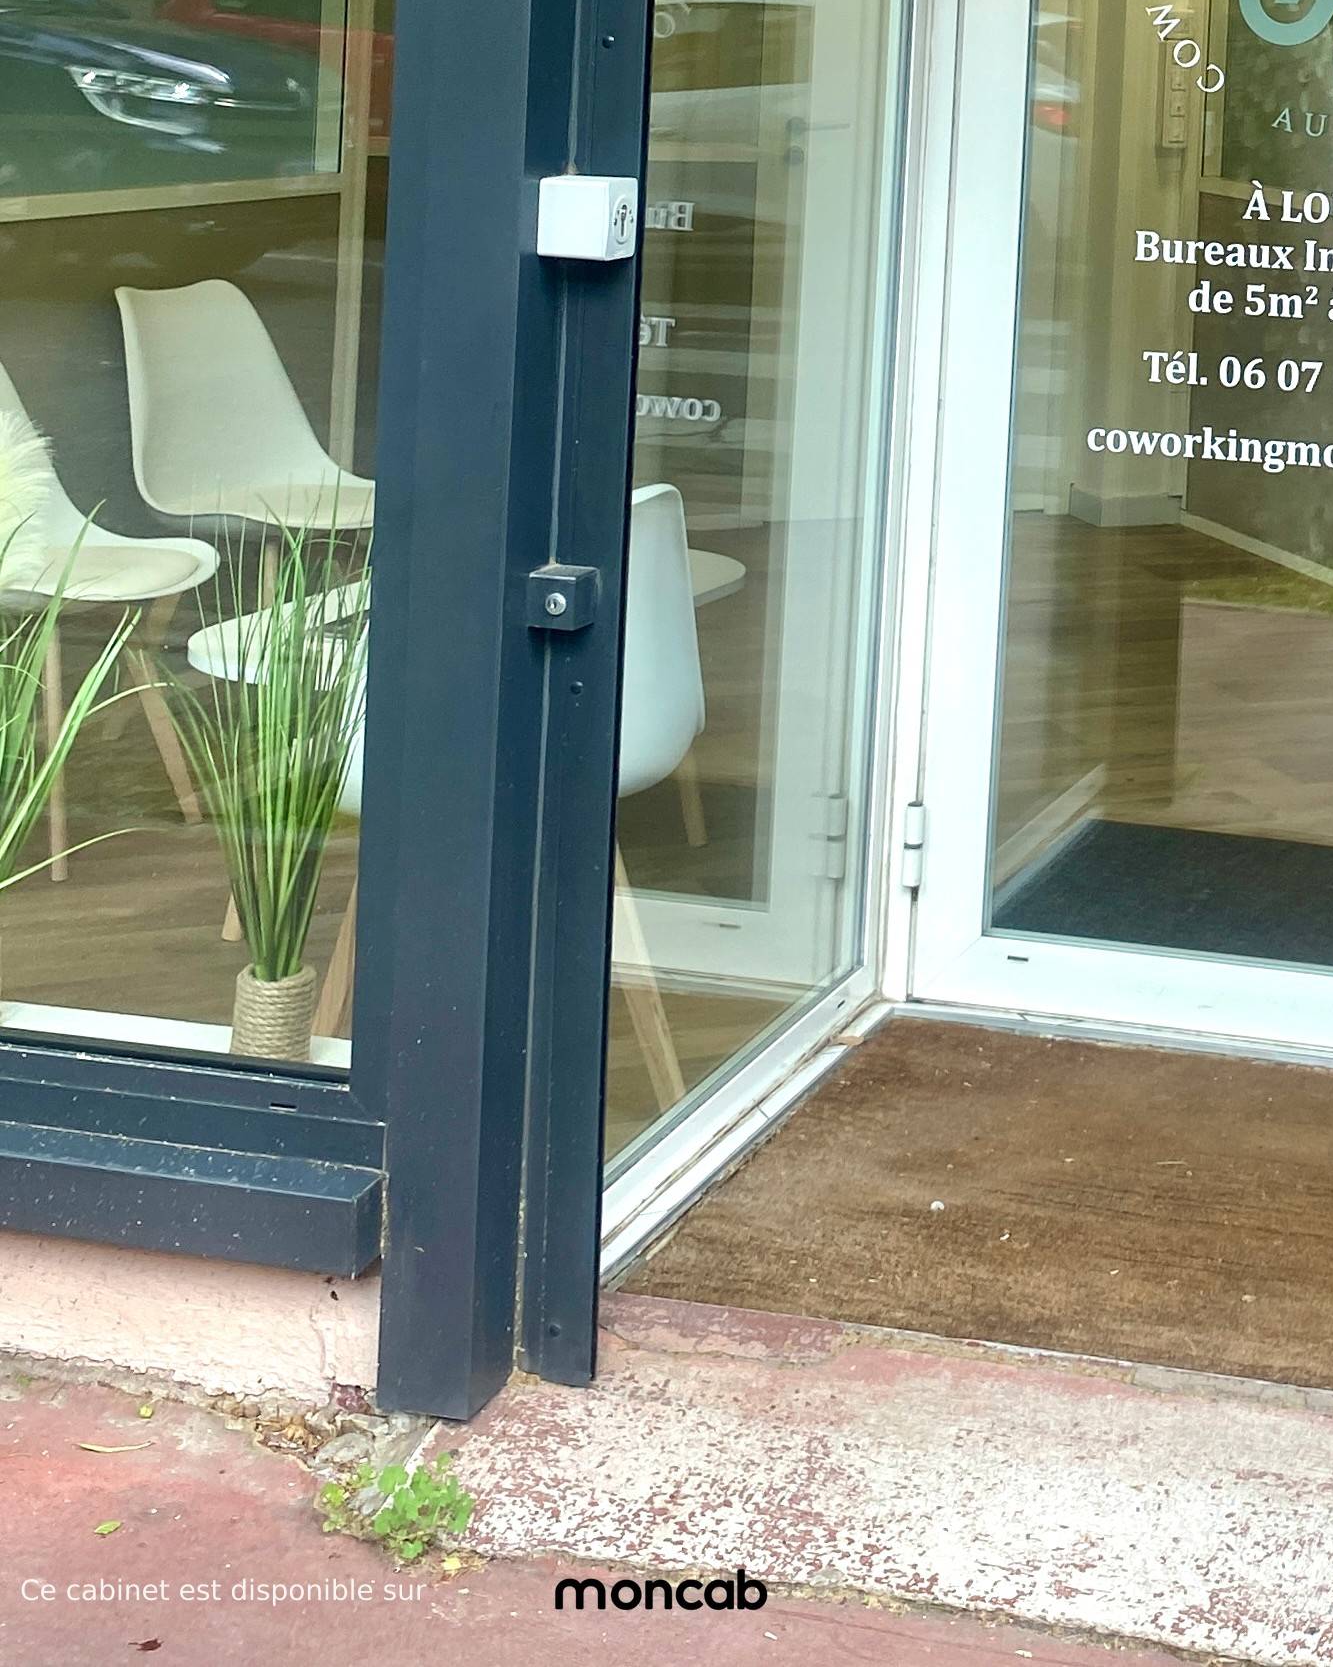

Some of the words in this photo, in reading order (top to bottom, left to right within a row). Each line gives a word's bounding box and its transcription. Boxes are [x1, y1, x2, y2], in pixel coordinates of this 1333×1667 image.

[1272, 107, 1329, 137] AU
[1242, 179, 1271, 222] À
[1134, 230, 1294, 270] Bureaux
[1188, 280, 1234, 315] de
[1244, 283, 1319, 320] 5m²
[1143, 350, 1208, 386] Tél.
[1218, 355, 1266, 390] 06
[1277, 358, 1323, 394] 07
